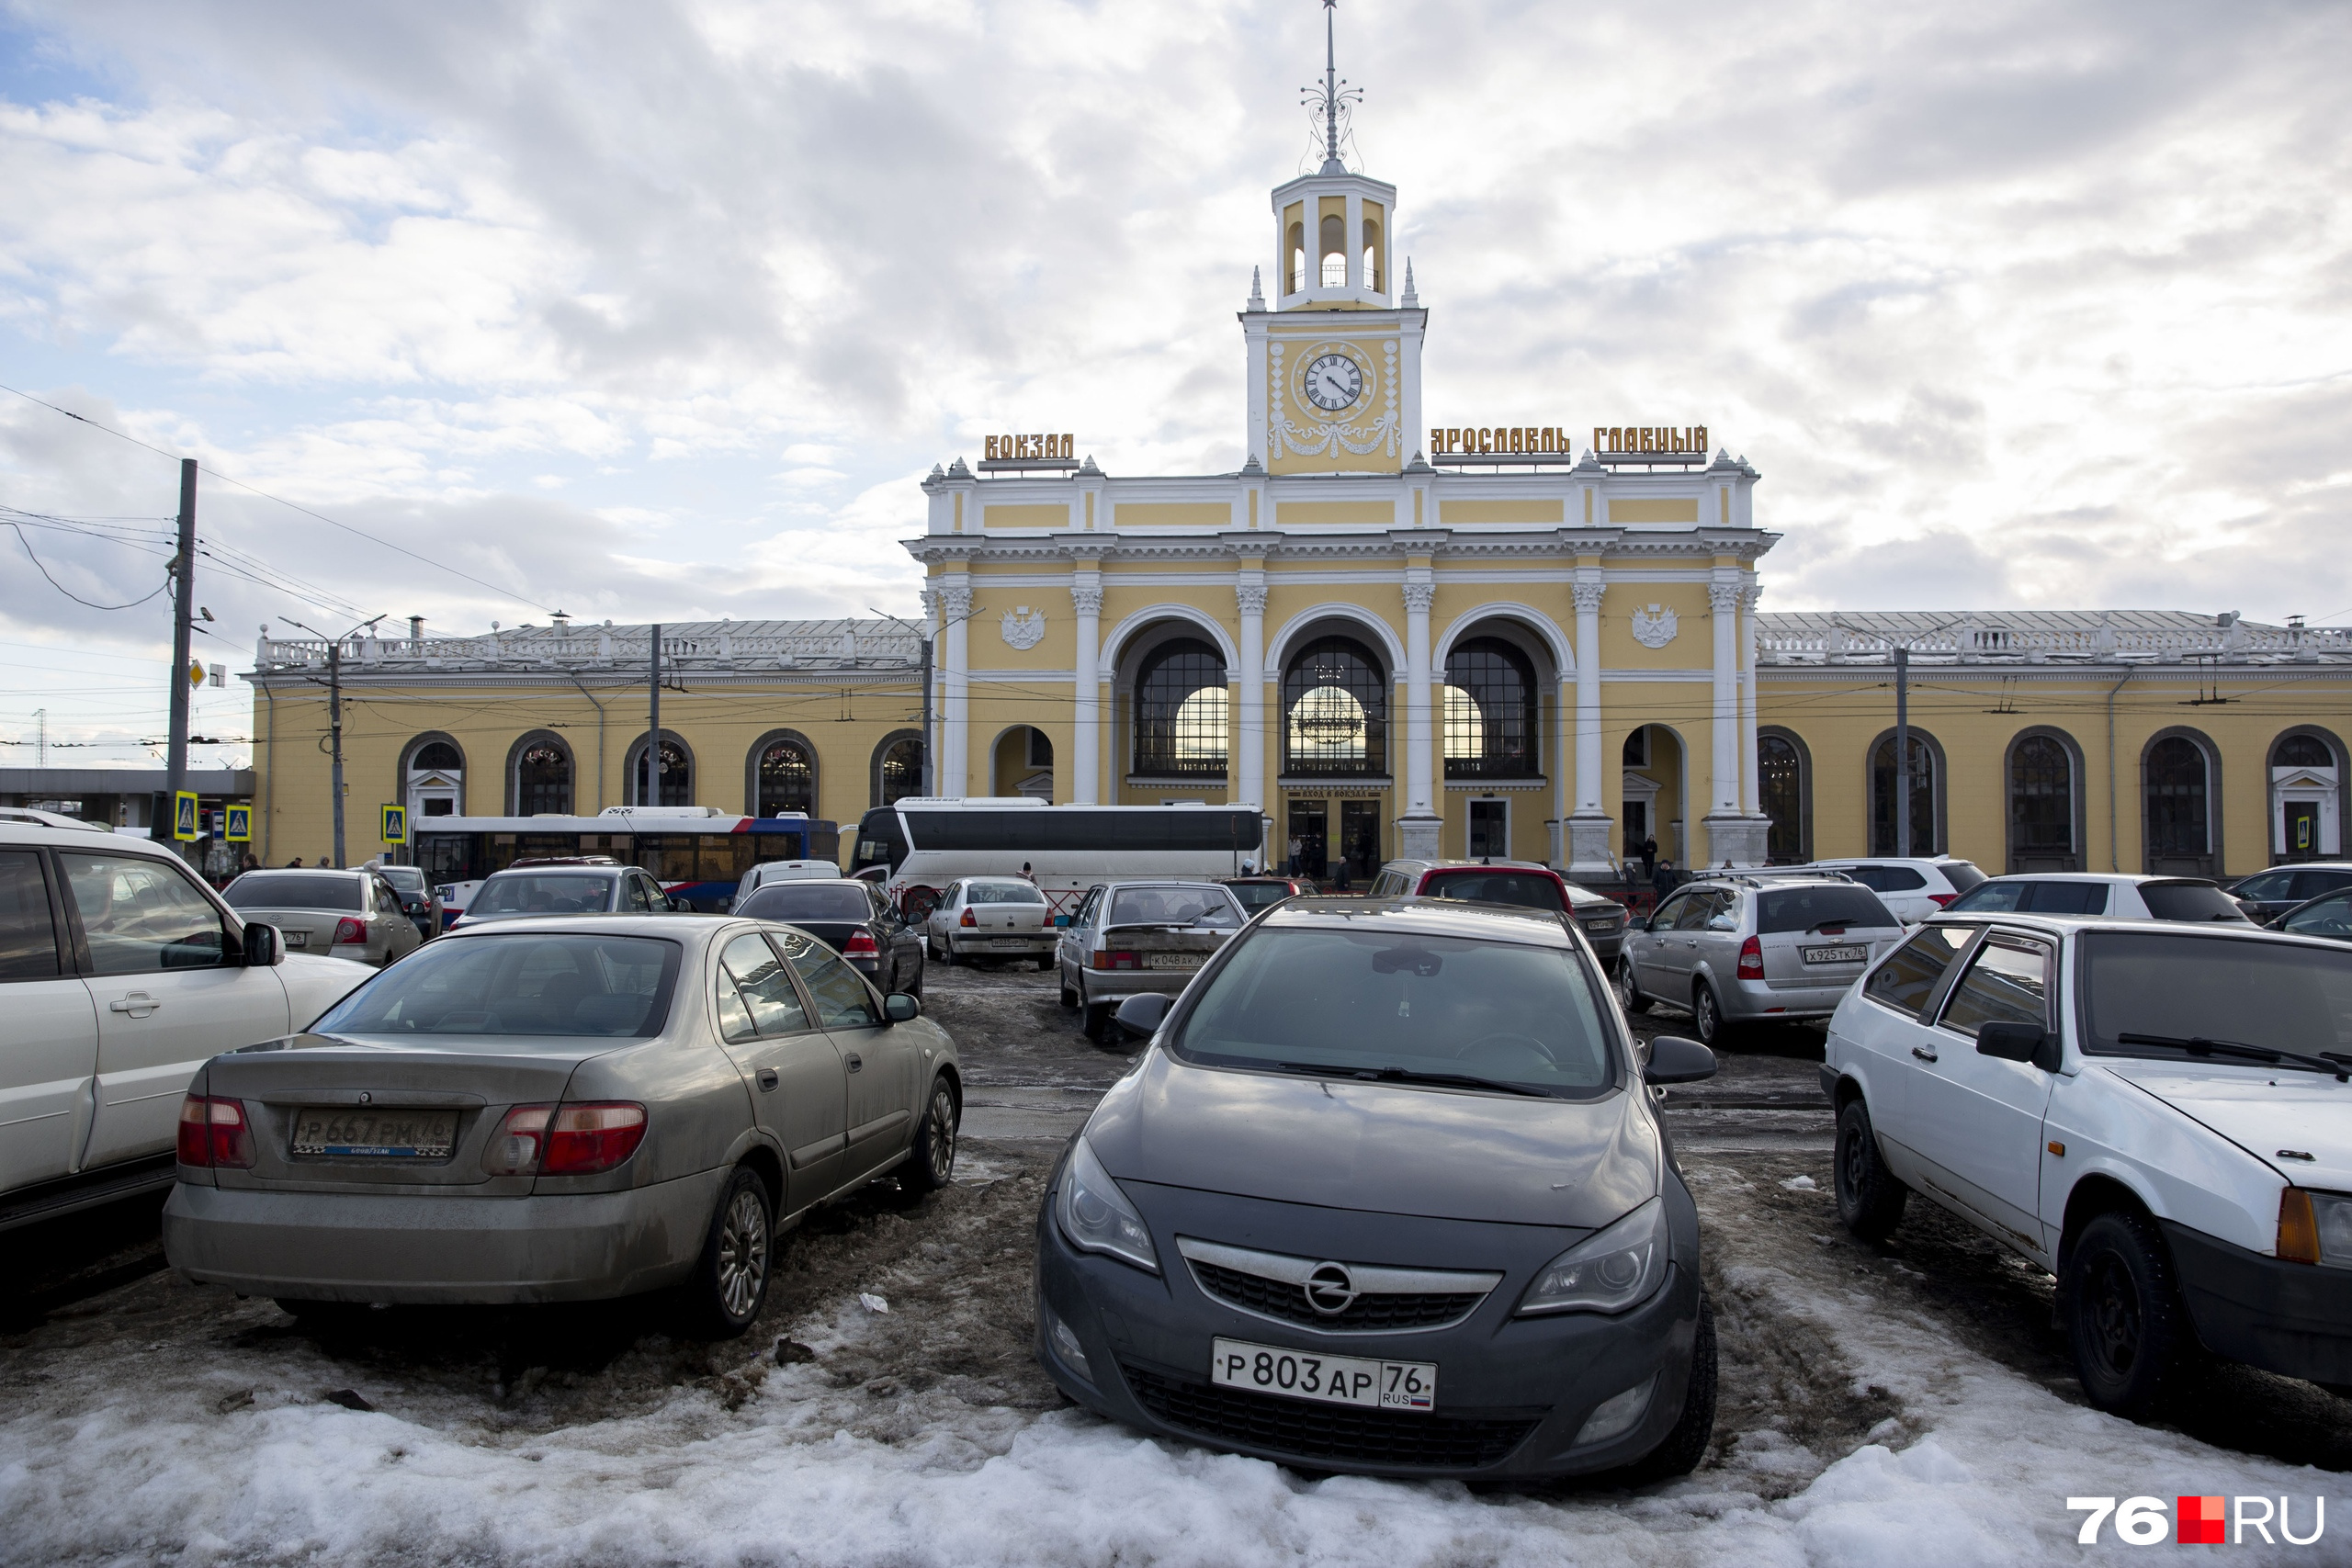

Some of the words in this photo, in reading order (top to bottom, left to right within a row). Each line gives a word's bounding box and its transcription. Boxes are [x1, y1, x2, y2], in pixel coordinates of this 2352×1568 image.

[985, 434, 1073, 459] ВОКЗАЛ
[1431, 427, 1570, 453] ЯРОСЛАВЛЬ
[1594, 424, 1708, 453] ГЛАВНЫЙ
[1155, 955, 1193, 965] К048АК
[1196, 954, 1205, 963] 76
[1810, 950, 1851, 961] Х925ТК
[1853, 947, 1863, 955] 76
[420, 1114, 446, 1137] 76
[416, 1137, 435, 1145] RUS
[1227, 1352, 1373, 1398] Р803АР
[1386, 1366, 1422, 1393] 76
[1383, 1393, 1409, 1404] RUS
